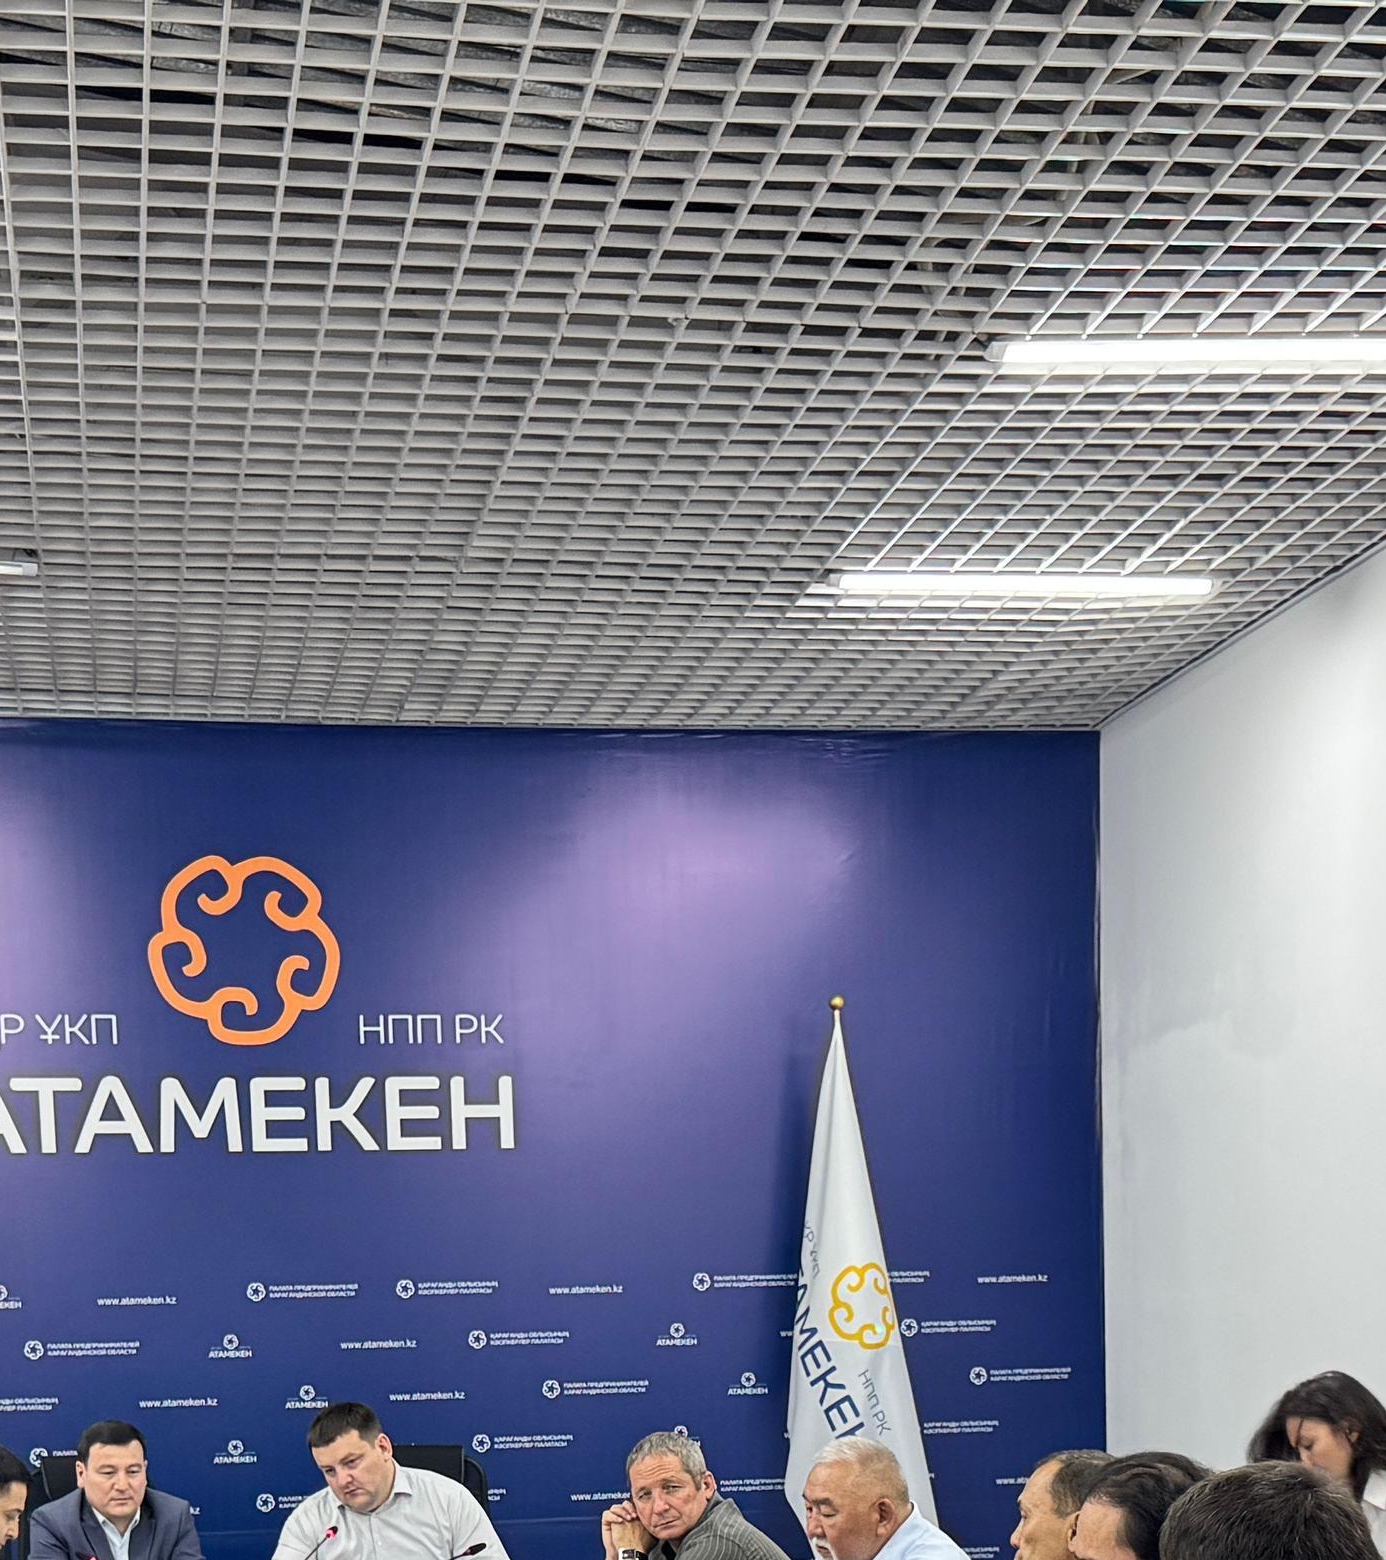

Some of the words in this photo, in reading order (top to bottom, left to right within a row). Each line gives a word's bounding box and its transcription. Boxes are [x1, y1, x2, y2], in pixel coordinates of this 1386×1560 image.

[34, 1013, 118, 1045] ҰКП
[359, 1013, 442, 1045] НПП
[454, 1013, 504, 1045] РК
[977, 1274, 1049, 1283] www.atameken.kz
[549, 1284, 623, 1295] www.atameken.kz
[97, 1295, 178, 1306] www.atameken.kz
[340, 1339, 417, 1350] www.atameken.kz
[656, 1338, 697, 1346] АТАМЕКЕН
[208, 1350, 252, 1359] АТАМЕКЕН
[389, 1390, 467, 1401] www.atameken.kz
[727, 1387, 768, 1395] АТАМЕКЕН
[139, 1397, 219, 1408] www.atameken.kz
[285, 1400, 328, 1409] АТАМЕКЕН
[858, 1369, 880, 1410] НПП
[873, 1408, 892, 1435] РК
[213, 1455, 257, 1464] АТАМЕКЕН
